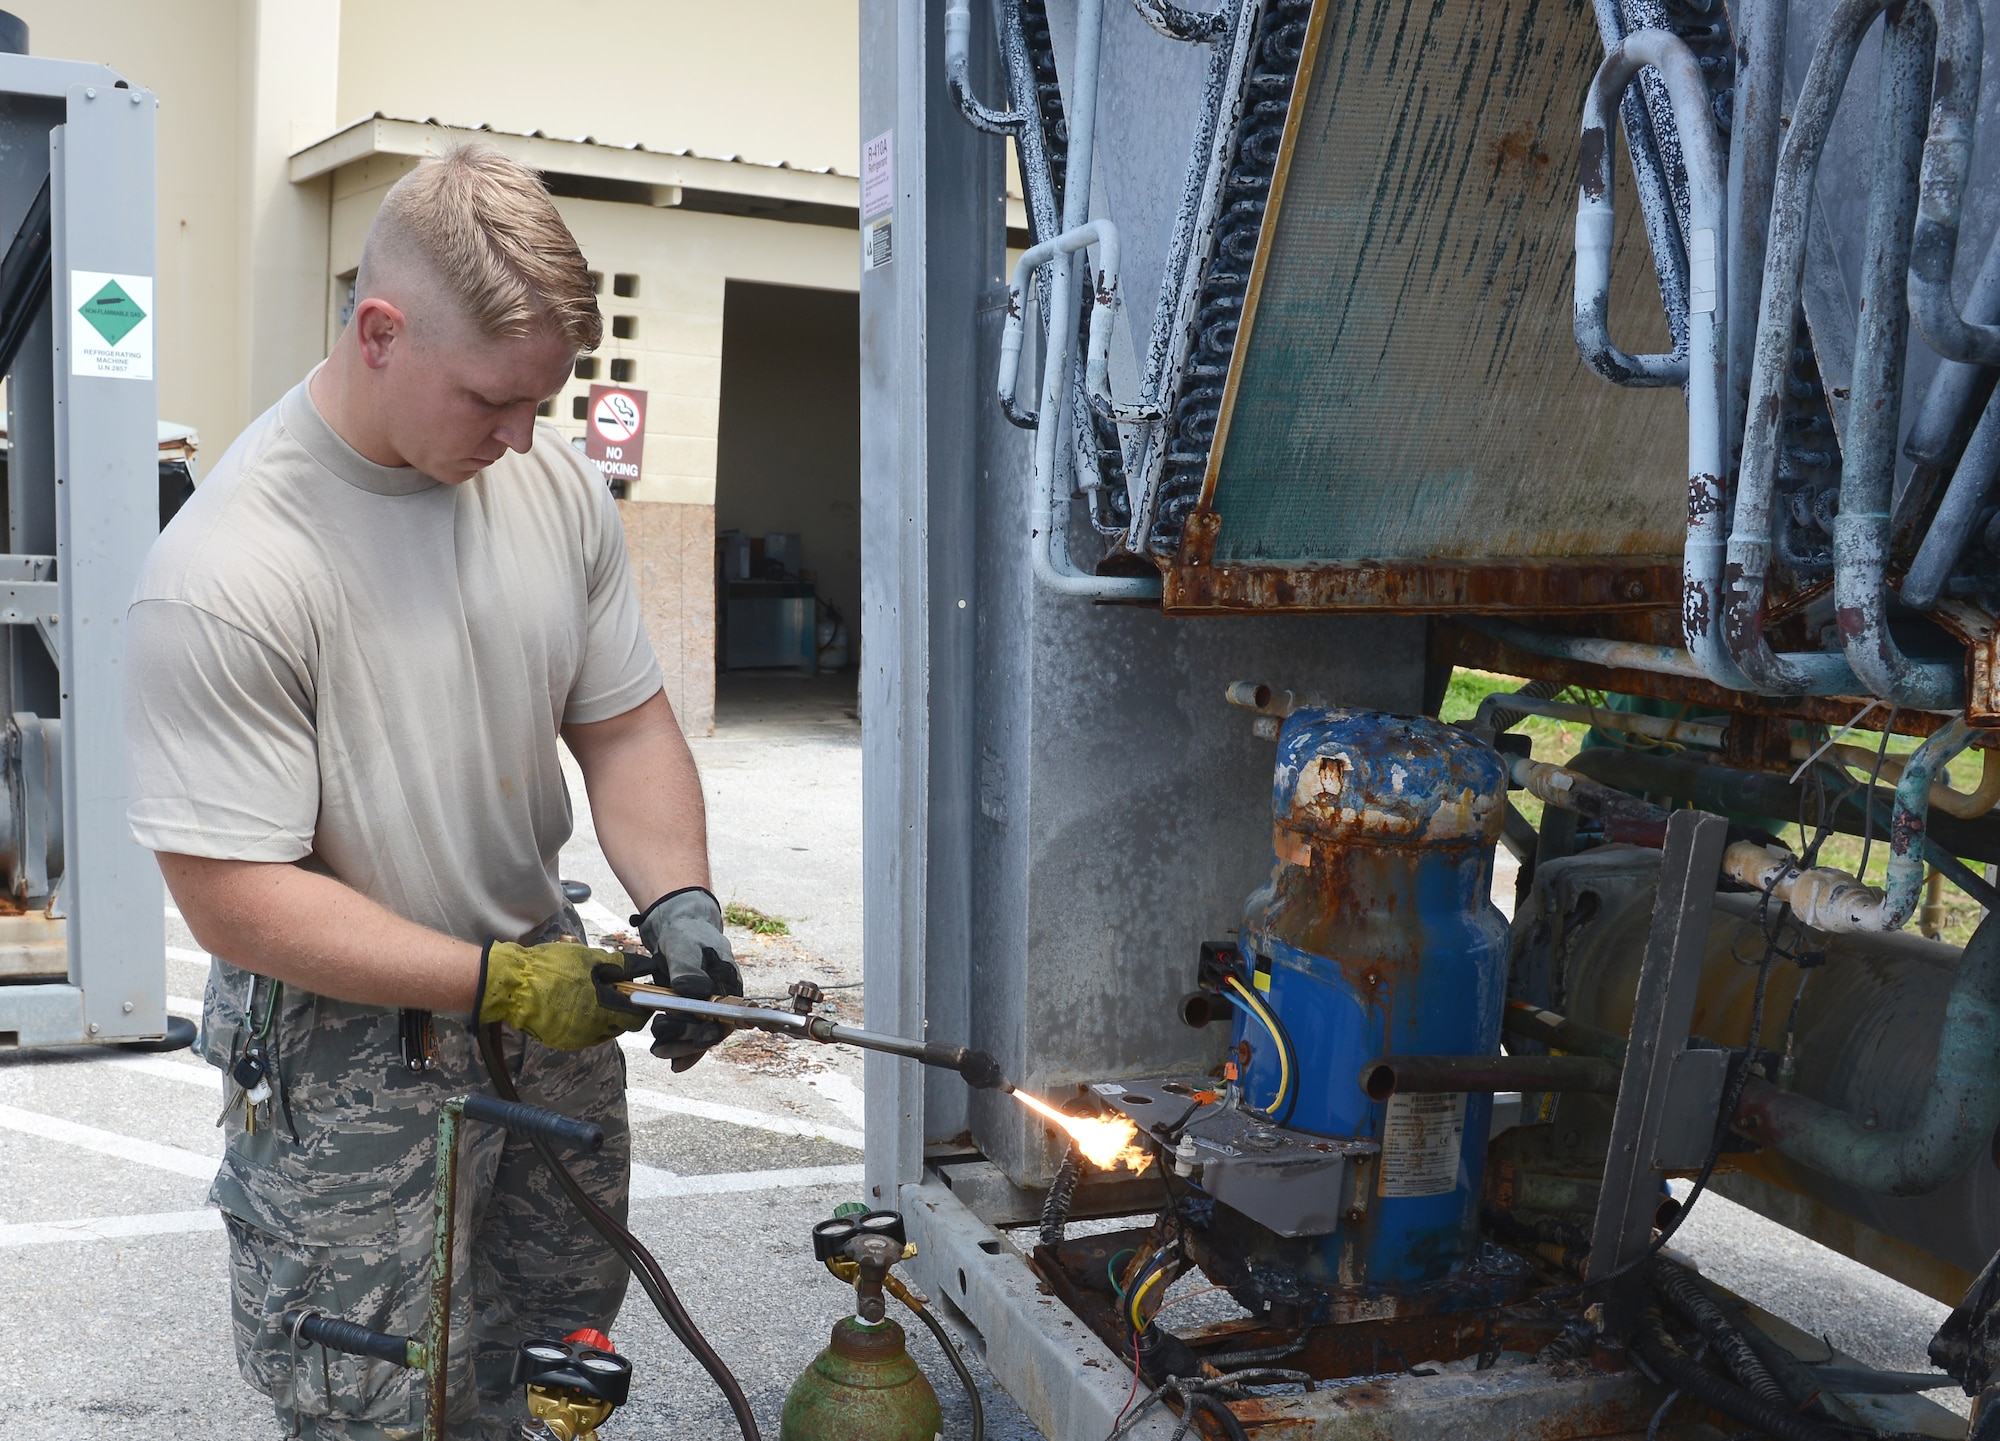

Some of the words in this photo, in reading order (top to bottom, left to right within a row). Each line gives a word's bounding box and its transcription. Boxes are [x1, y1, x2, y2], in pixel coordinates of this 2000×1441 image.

[868, 138, 888, 162] R-410A
[868, 156, 888, 173] Refrigerant
[85, 308, 130, 317] NON-FLAMMABLE
[84, 349, 141, 359] REFRIGERATING
[96, 357, 129, 365] MACHINE
[606, 446, 623, 460] NO
